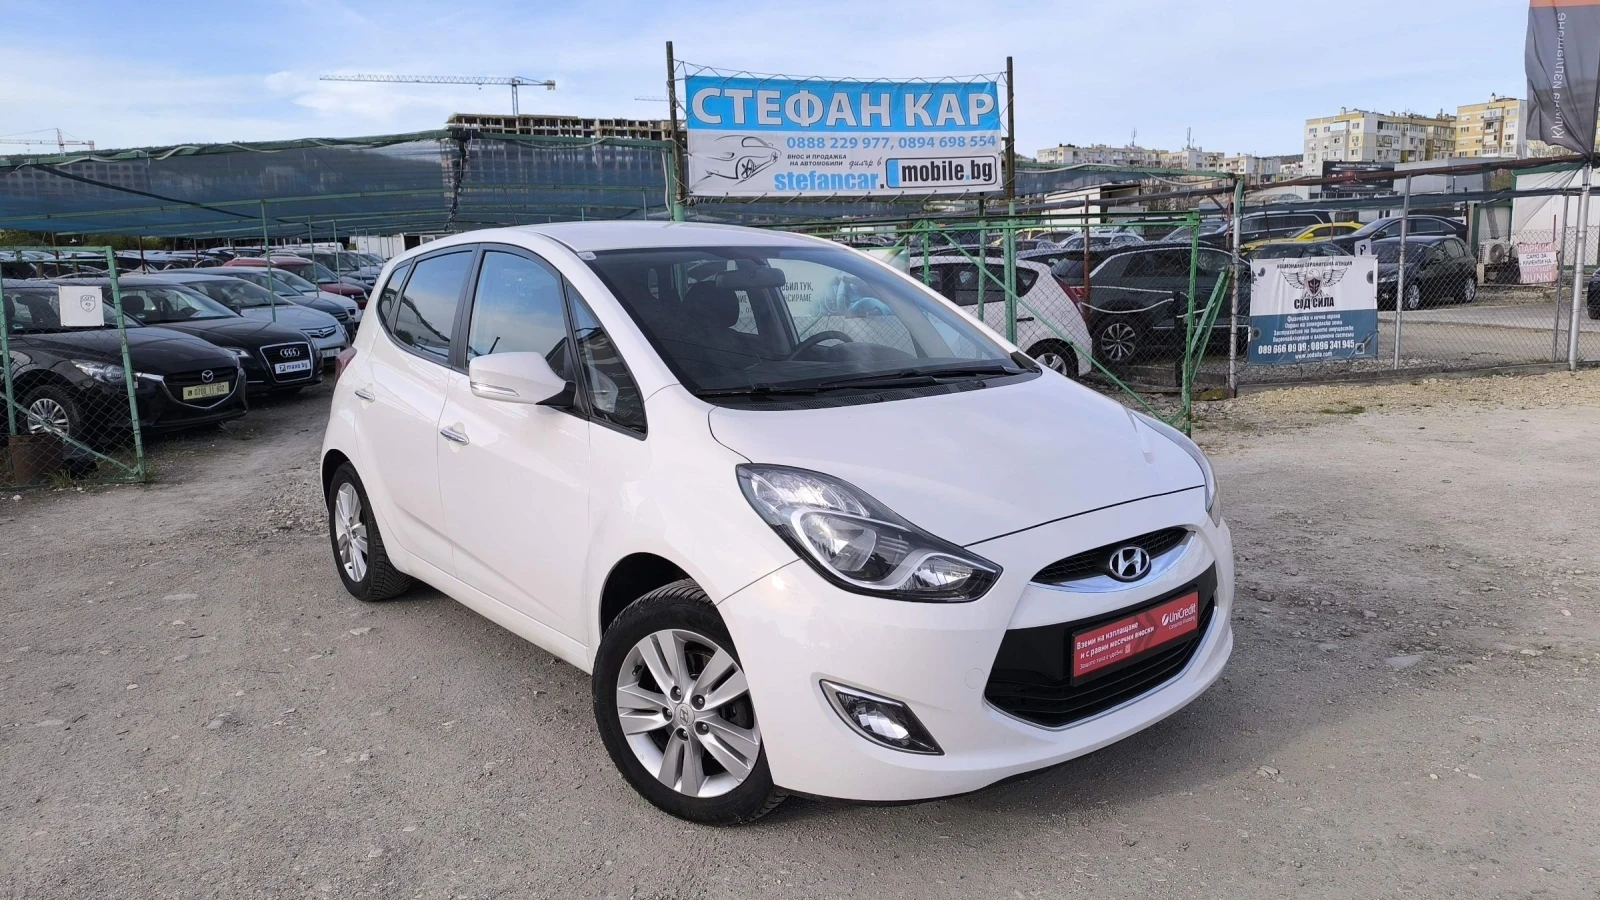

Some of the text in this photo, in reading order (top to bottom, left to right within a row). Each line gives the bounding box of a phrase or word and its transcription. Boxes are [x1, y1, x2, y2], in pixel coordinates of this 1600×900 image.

[691, 87, 995, 127] СТЕФАН КАР
[787, 135, 996, 150] 0888 229 977, 0894 698 554
[901, 159, 993, 182] mobile.bg
[1523, 272, 1552, 283] NUNKI
[800, 281, 814, 292] ТУК,
[1294, 297, 1335, 310] СОД СИЛА
[1273, 343, 1287, 354] 666
[1311, 341, 1329, 351] 0896
[1330, 340, 1341, 349] 341
[1342, 339, 1355, 349] 945
[1169, 603, 1196, 623] UniCredit
[1076, 622, 1139, 650] Вземи на изплащане
[1090, 643, 1109, 657] равни
[1109, 634, 1134, 649] месечни
[1134, 625, 1155, 639] вноски
